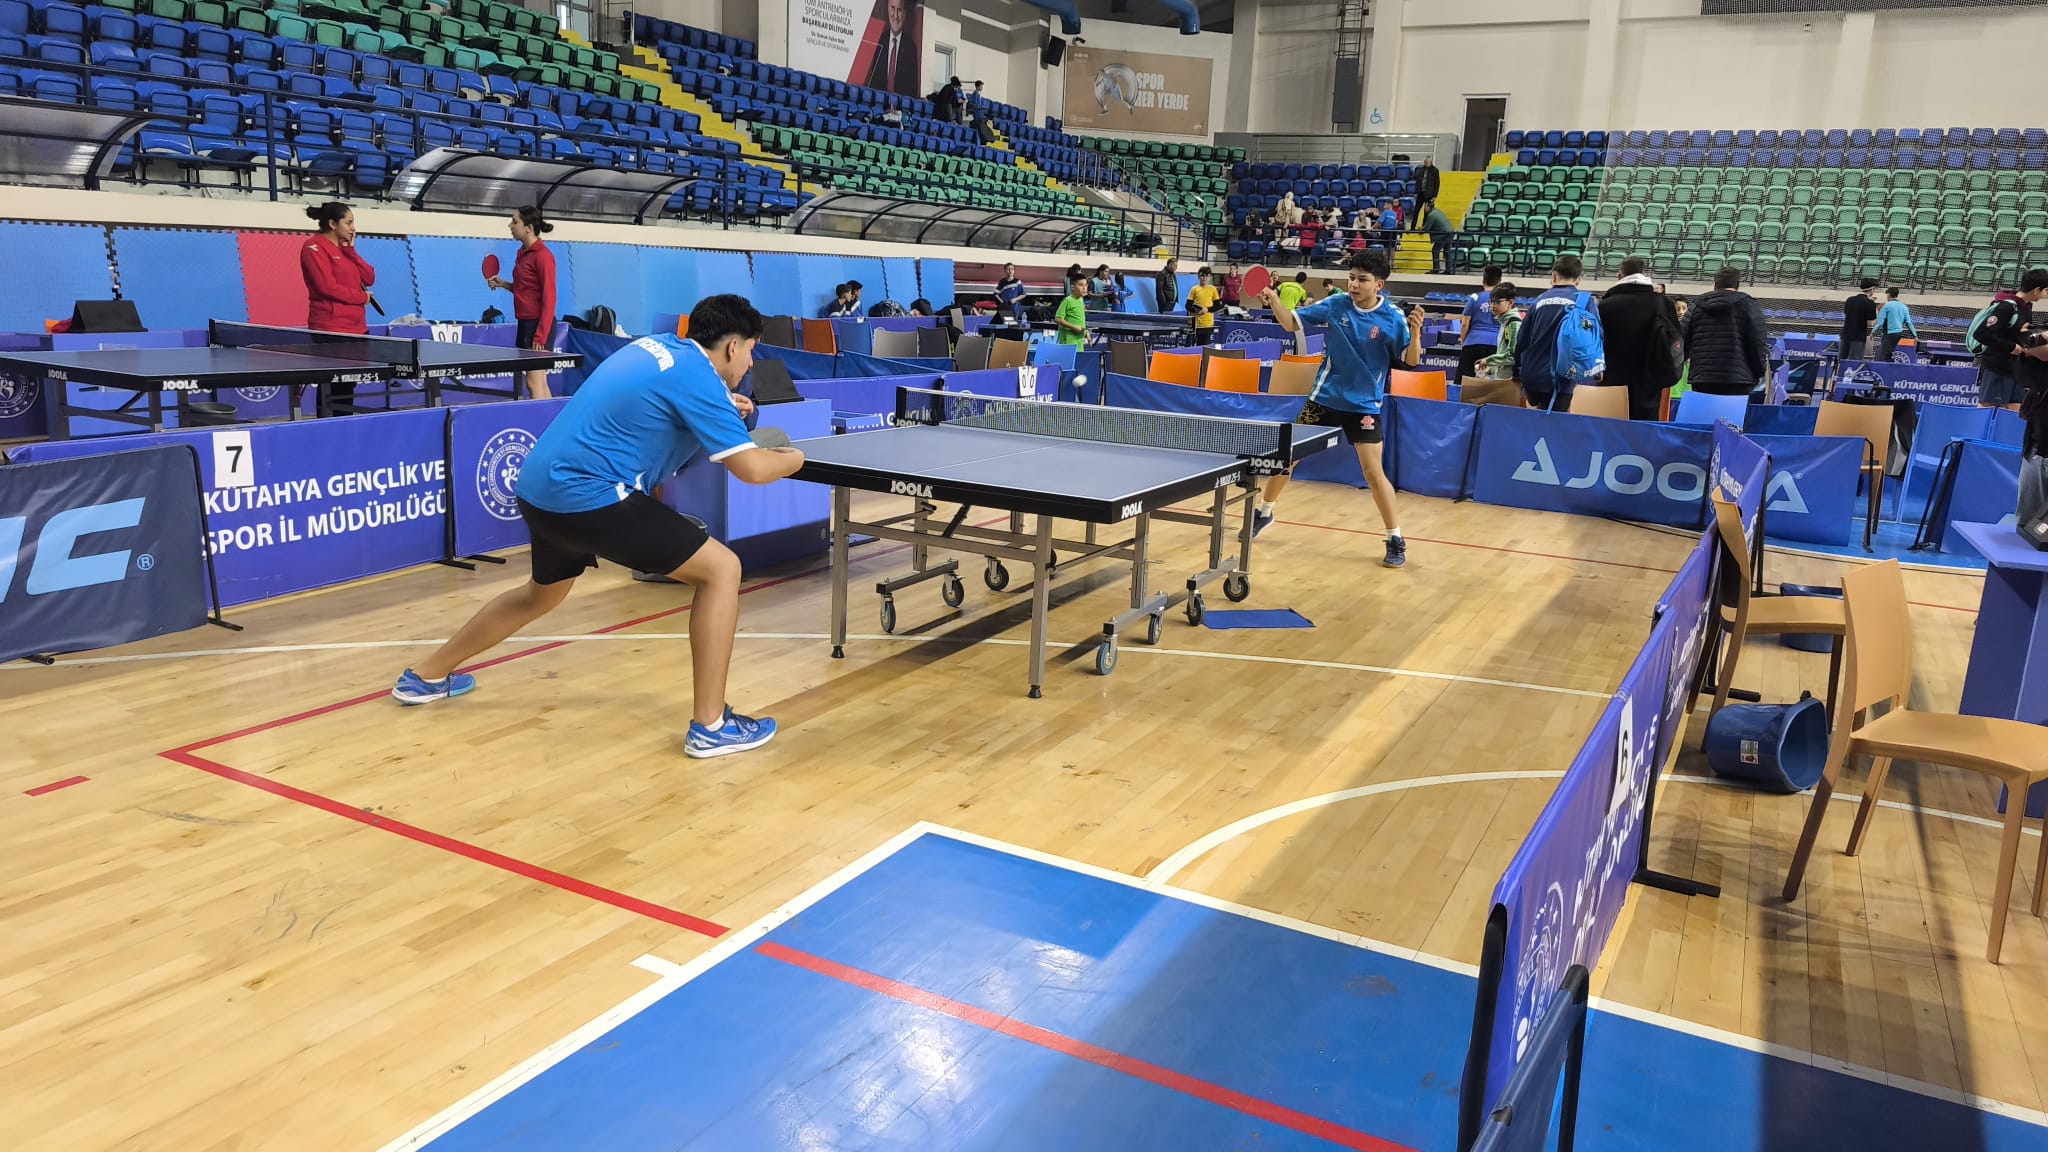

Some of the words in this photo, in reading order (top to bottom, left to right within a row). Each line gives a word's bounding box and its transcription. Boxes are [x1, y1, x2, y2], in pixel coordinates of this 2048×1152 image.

[1135, 72, 1165, 90] SPOR
[1158, 92, 1190, 111] YERDE
[554, 360, 576, 369] JOOLA
[48, 368, 68, 380] JOOLA
[163, 379, 199, 391] JOOLA
[1894, 380, 1938, 391] KÜTAHYA
[1940, 383, 1980, 395] GENÇLİK
[1890, 392, 1916, 402] SPOR
[1917, 393, 1927, 403] İL
[225, 445, 243, 473] 7
[1250, 457, 1285, 469] JOOLA
[203, 478, 322, 515] KÜTAHYA
[327, 461, 419, 495] GENÇLİK
[421, 460, 445, 481] VE
[890, 480, 933, 498] JOOLA
[1564, 451, 1810, 514] JOOA
[1121, 500, 1143, 519] JOOLA
[201, 523, 274, 561] SPOR
[279, 515, 302, 543] İL
[308, 488, 447, 538] MÜDÜRLÜĞÜ
[1620, 729, 1629, 785] 6
